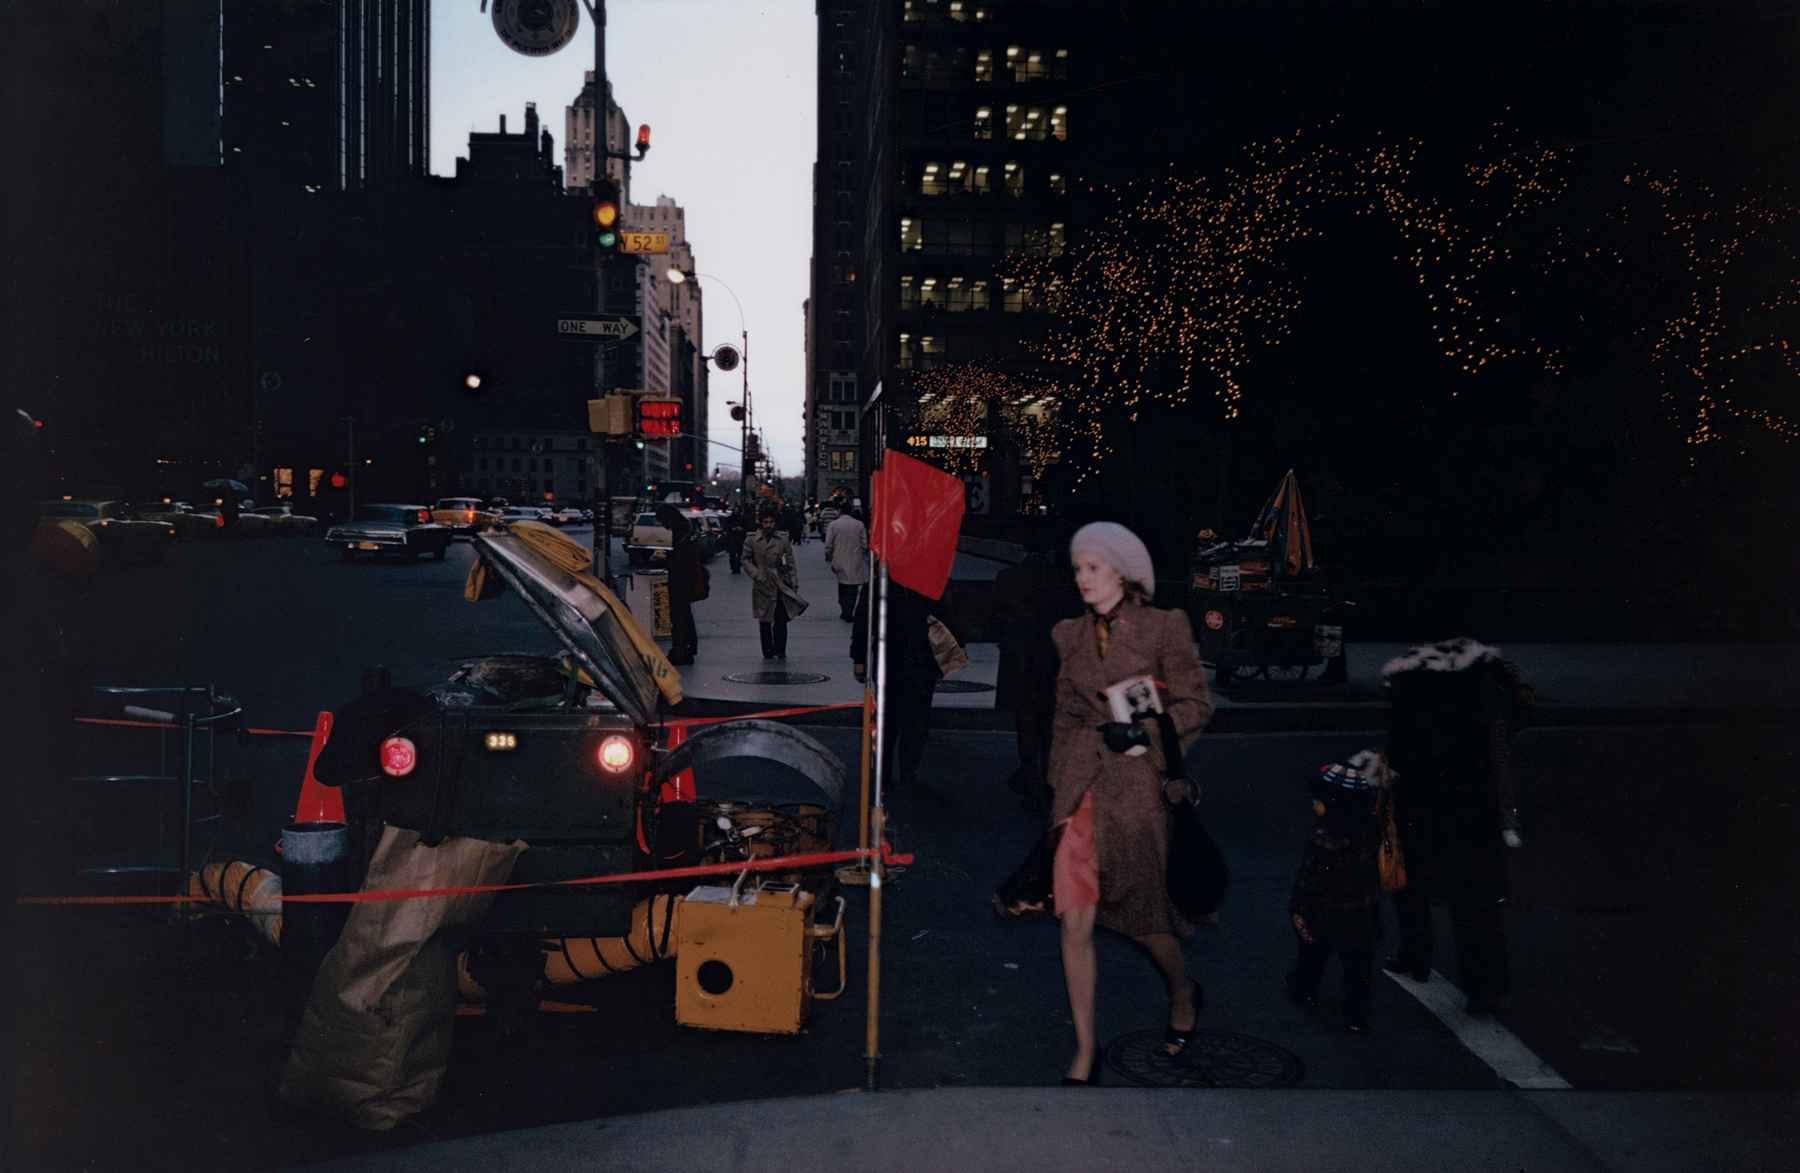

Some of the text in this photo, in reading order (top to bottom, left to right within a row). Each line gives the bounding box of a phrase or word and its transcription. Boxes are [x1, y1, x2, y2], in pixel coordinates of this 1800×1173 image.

[501, 29, 573, 54] DE PUERTO RICO
[634, 235, 652, 251] 52
[655, 236, 665, 245] ST
[96, 294, 136, 312] THE
[95, 319, 218, 338] NEW YORK
[561, 321, 628, 334] ONE WAY
[141, 344, 219, 363] HILTON
[819, 413, 828, 468] WARWICK
[907, 435, 928, 447] 415
